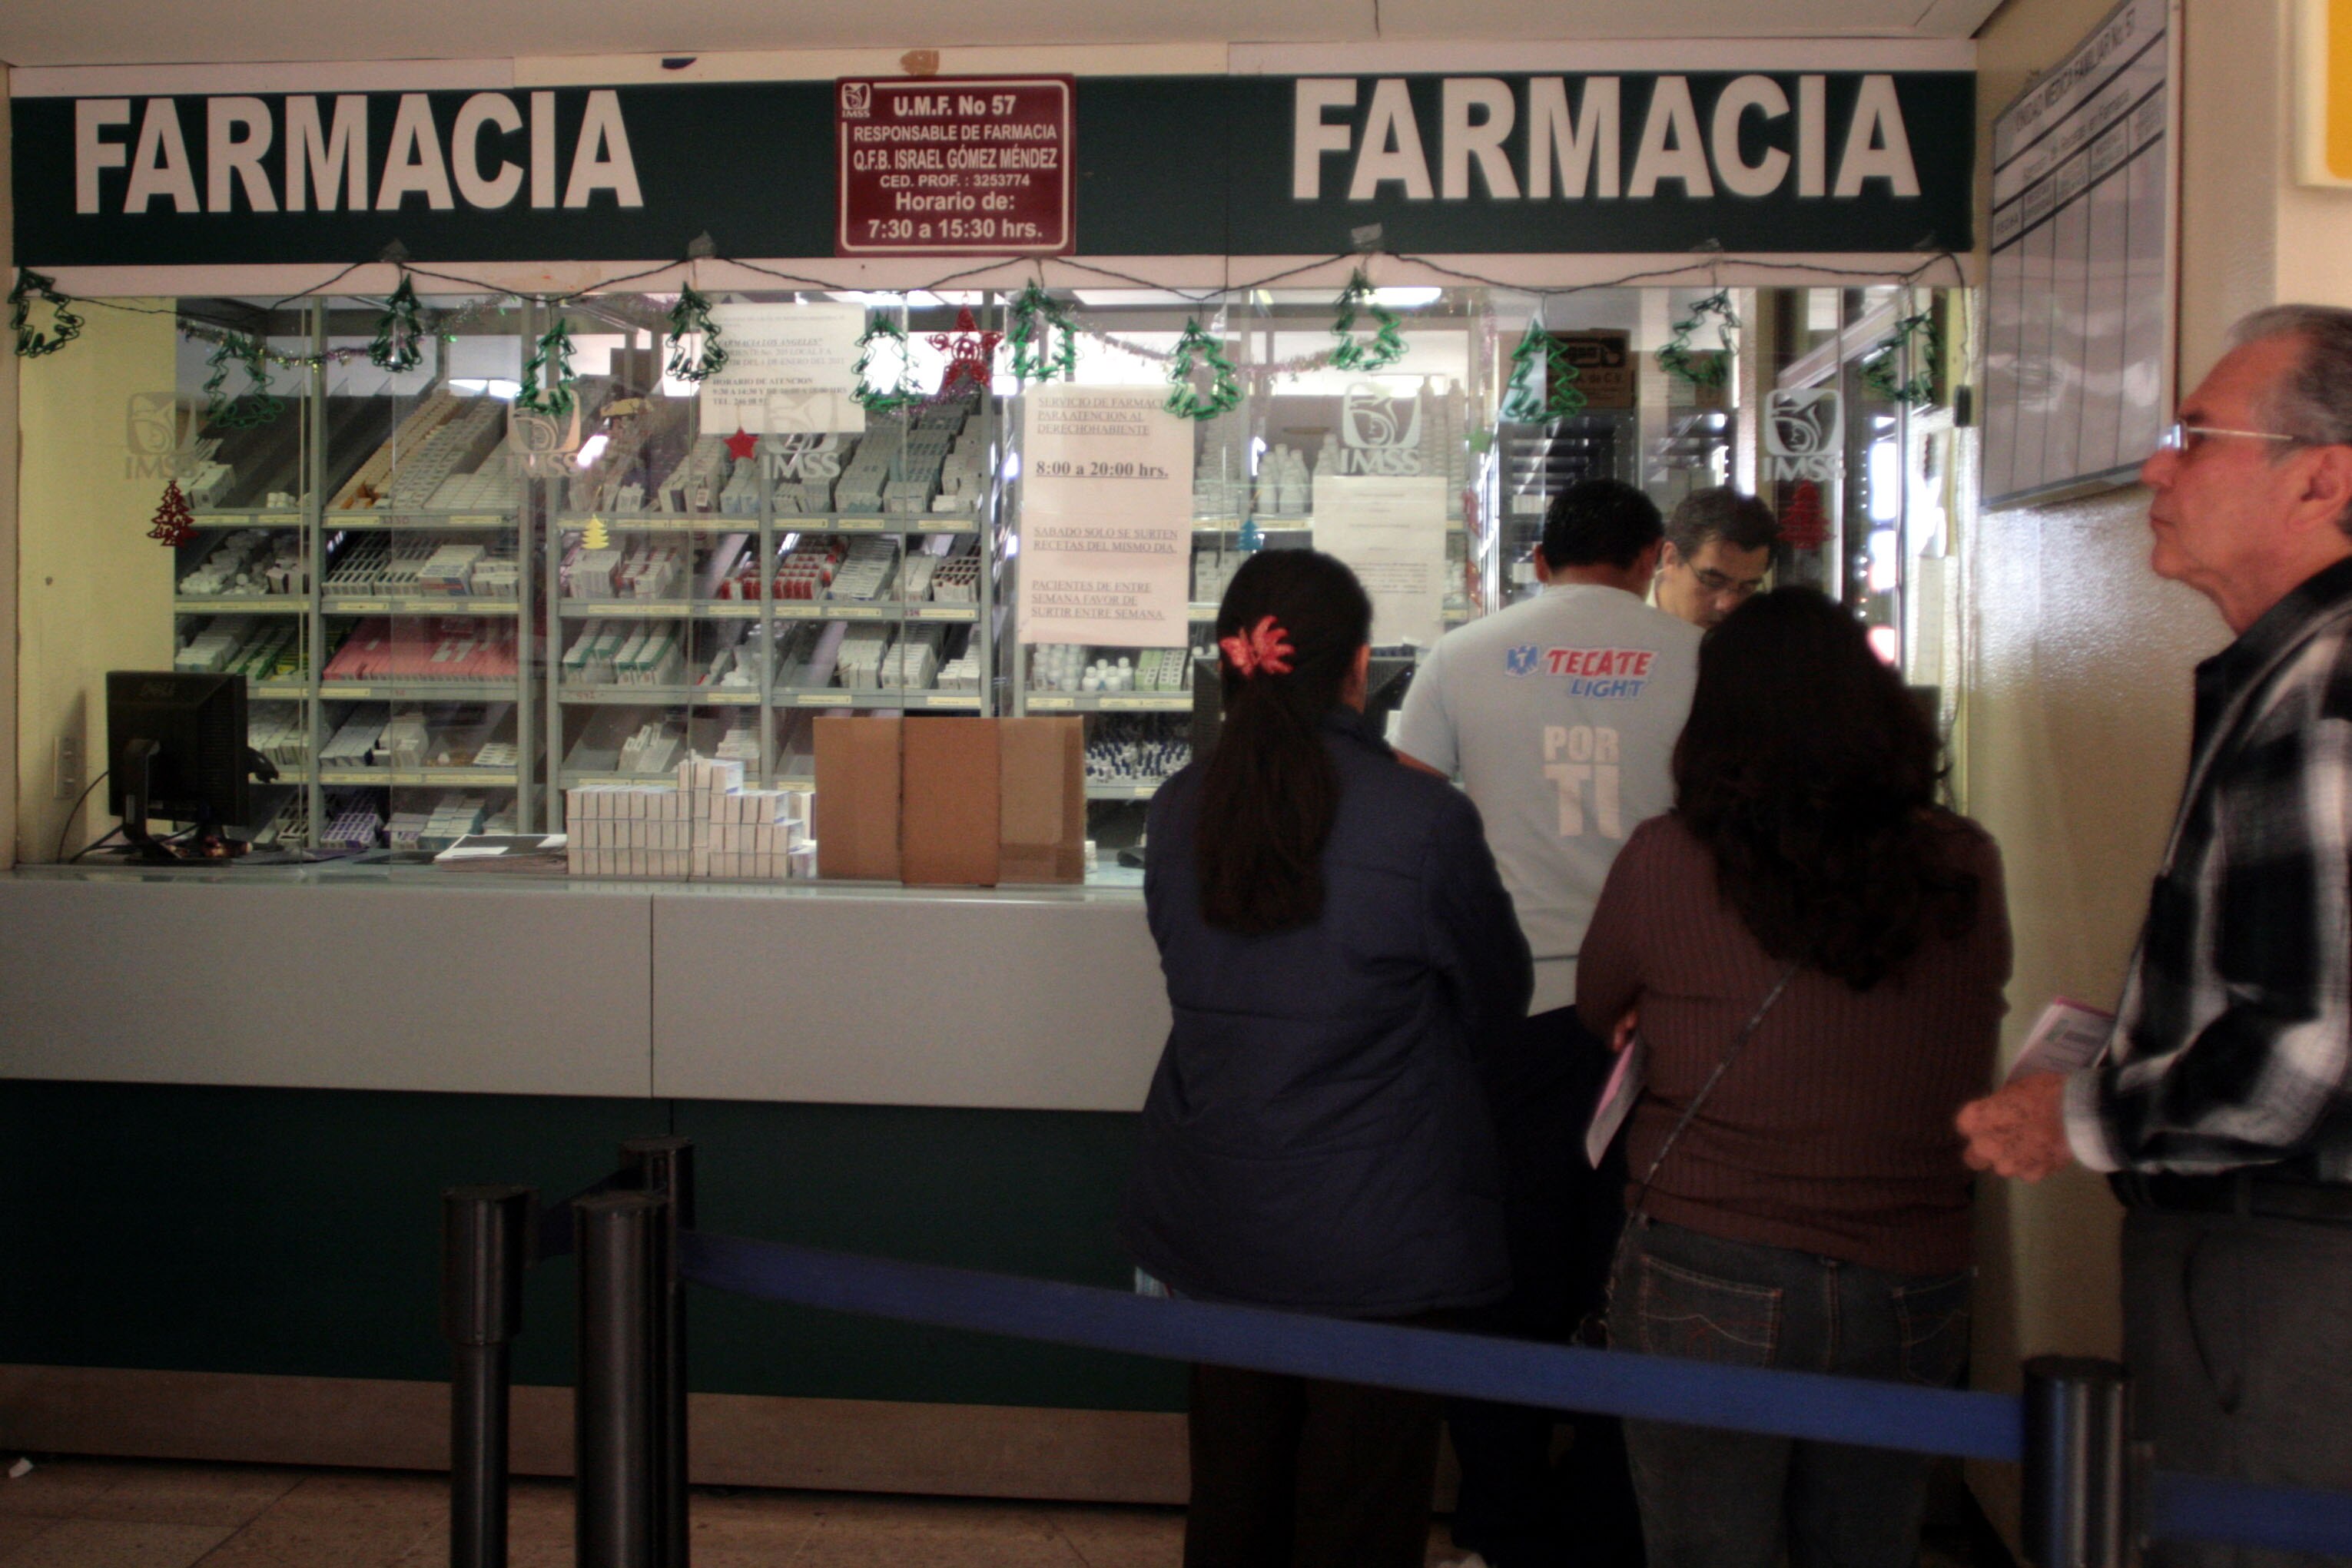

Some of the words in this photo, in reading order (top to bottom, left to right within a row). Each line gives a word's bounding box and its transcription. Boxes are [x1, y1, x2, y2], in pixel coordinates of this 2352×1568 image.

[894, 96, 952, 116] U.M.F.
[959, 96, 986, 114] No
[992, 95, 1017, 114] 57
[854, 125, 957, 141] RESPONSABLE
[961, 125, 980, 141] DE
[984, 124, 1057, 140] FARMACIA
[1292, 75, 1921, 201] FARMACIA
[75, 91, 644, 215] FARMACIA
[854, 149, 891, 171] Q.F.B.
[895, 148, 944, 170] ISRAEL
[947, 144, 997, 168] GÓMEZ
[1000, 144, 1057, 168] MÉNDEZ
[880, 175, 914, 187] CED.
[918, 174, 960, 187] PROF.
[974, 174, 1030, 187] 3253774
[896, 191, 976, 211] Horario
[982, 191, 1015, 211] de:
[868, 220, 913, 238] 7:30
[919, 224, 931, 238] a
[938, 220, 995, 238] 15:30
[1002, 220, 1043, 238] hrs.
[1038, 397, 1093, 408] SERVICIO
[1093, 398, 1109, 408] DE
[1112, 398, 1165, 409] FARMACI
[1037, 410, 1070, 421] PARA
[1070, 410, 1127, 421] ATENCION
[1130, 412, 1144, 422] AL
[1037, 423, 1150, 436] DERECHOHABIENTE
[125, 454, 196, 479] IMSS
[506, 452, 579, 478] IMSS
[763, 452, 841, 479] IMSS
[1037, 461, 1071, 476] 8:00
[1076, 465, 1085, 476] a
[1090, 462, 1133, 477] 20:00
[1139, 461, 1169, 478] hrs.
[1341, 449, 1422, 474] IMSS
[1763, 455, 1846, 482] IMSS
[1034, 527, 1083, 539] SABADO
[1085, 528, 1115, 539] SOLO
[1118, 529, 1132, 539] SE
[1134, 529, 1178, 539] SURTEN
[1033, 540, 1084, 551] RECETAS
[1087, 541, 1109, 552] DEL
[1112, 542, 1151, 552] MISMO
[1033, 580, 1093, 592] PACIENTES
[1096, 582, 1112, 592] DE
[1115, 582, 1152, 592] ENTRE
[1032, 593, 1080, 604] SEMANA
[1082, 595, 1120, 605] FAVOR
[1123, 595, 1138, 606] DE
[1032, 607, 1070, 618] SURTIR
[1075, 608, 1113, 618] ENTRE
[1547, 650, 1652, 677] TECATE
[1571, 679, 1646, 697] LIGHT
[1544, 725, 1620, 761] POR
[1544, 763, 1623, 839] TI
